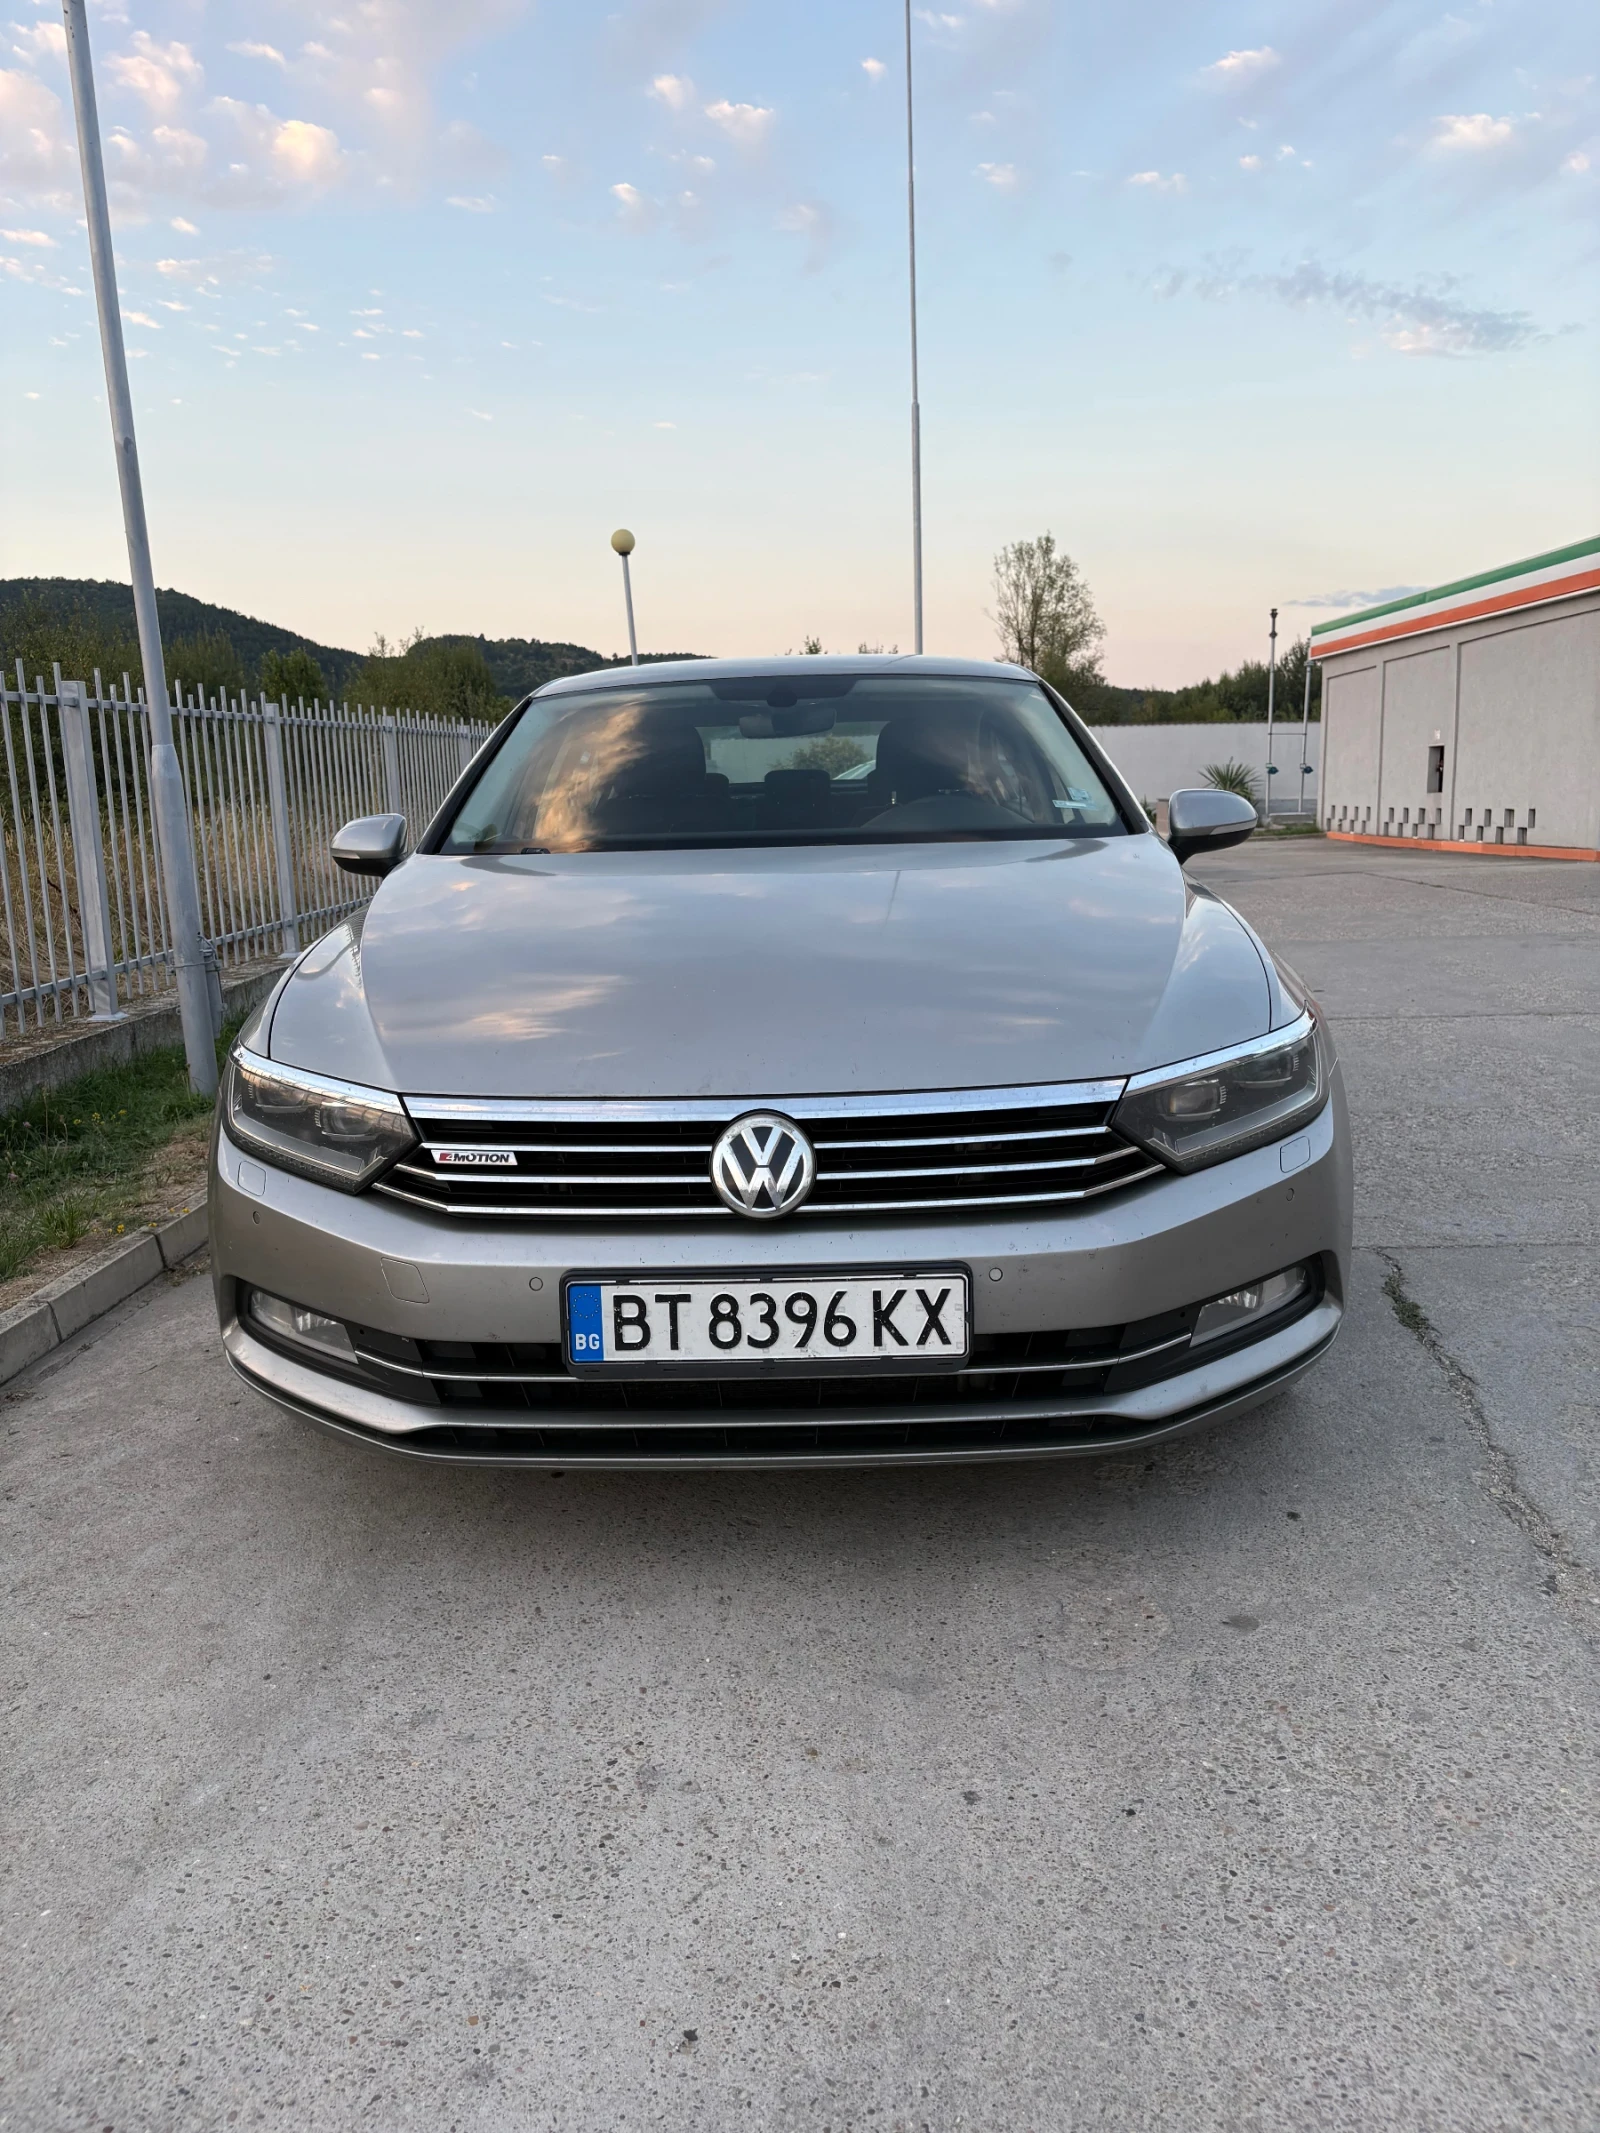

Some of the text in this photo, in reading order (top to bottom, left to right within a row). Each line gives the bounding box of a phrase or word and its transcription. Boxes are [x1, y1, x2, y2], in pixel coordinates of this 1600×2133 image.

[439, 1152, 510, 1163] 4MOTION
[613, 1288, 952, 1351] BT 8396 KX
[575, 1333, 600, 1351] BG
